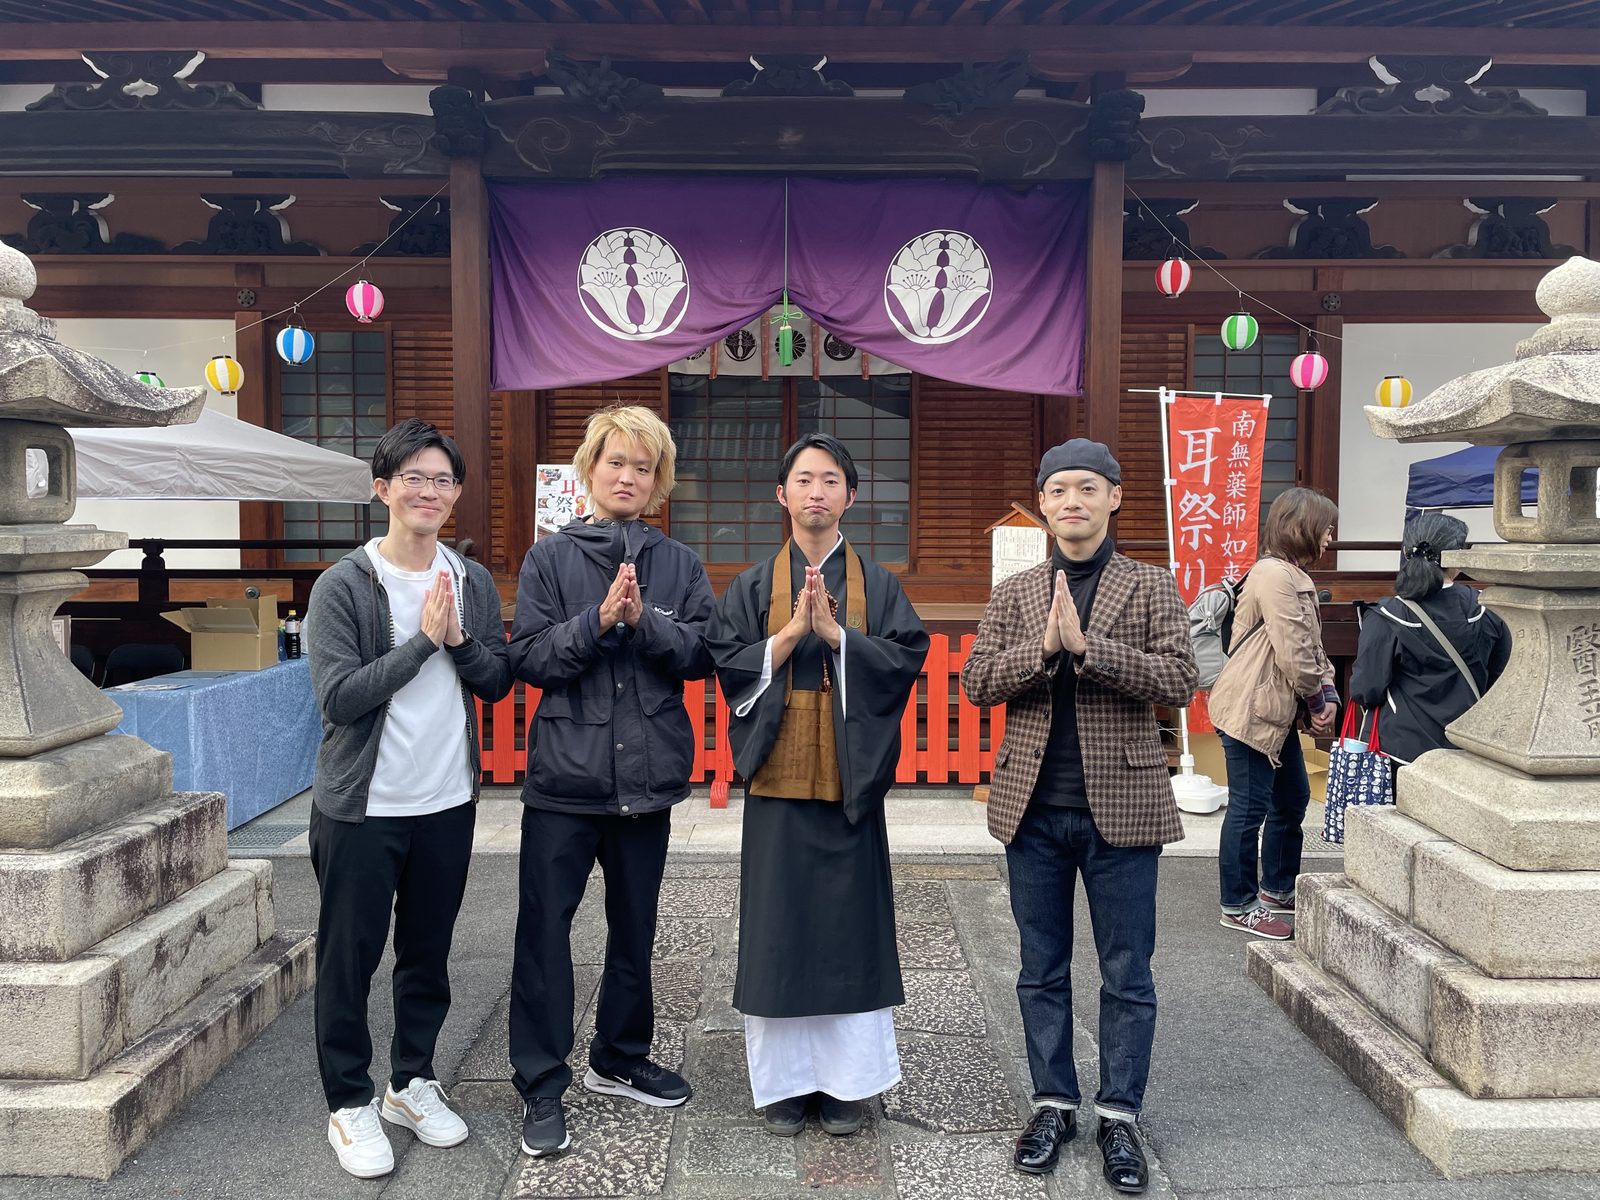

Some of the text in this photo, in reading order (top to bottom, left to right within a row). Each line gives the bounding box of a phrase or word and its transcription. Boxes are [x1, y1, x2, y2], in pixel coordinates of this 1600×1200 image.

[1178, 427, 1222, 594] 耳祭り
[1221, 410, 1256, 583] 南無薬師如来
